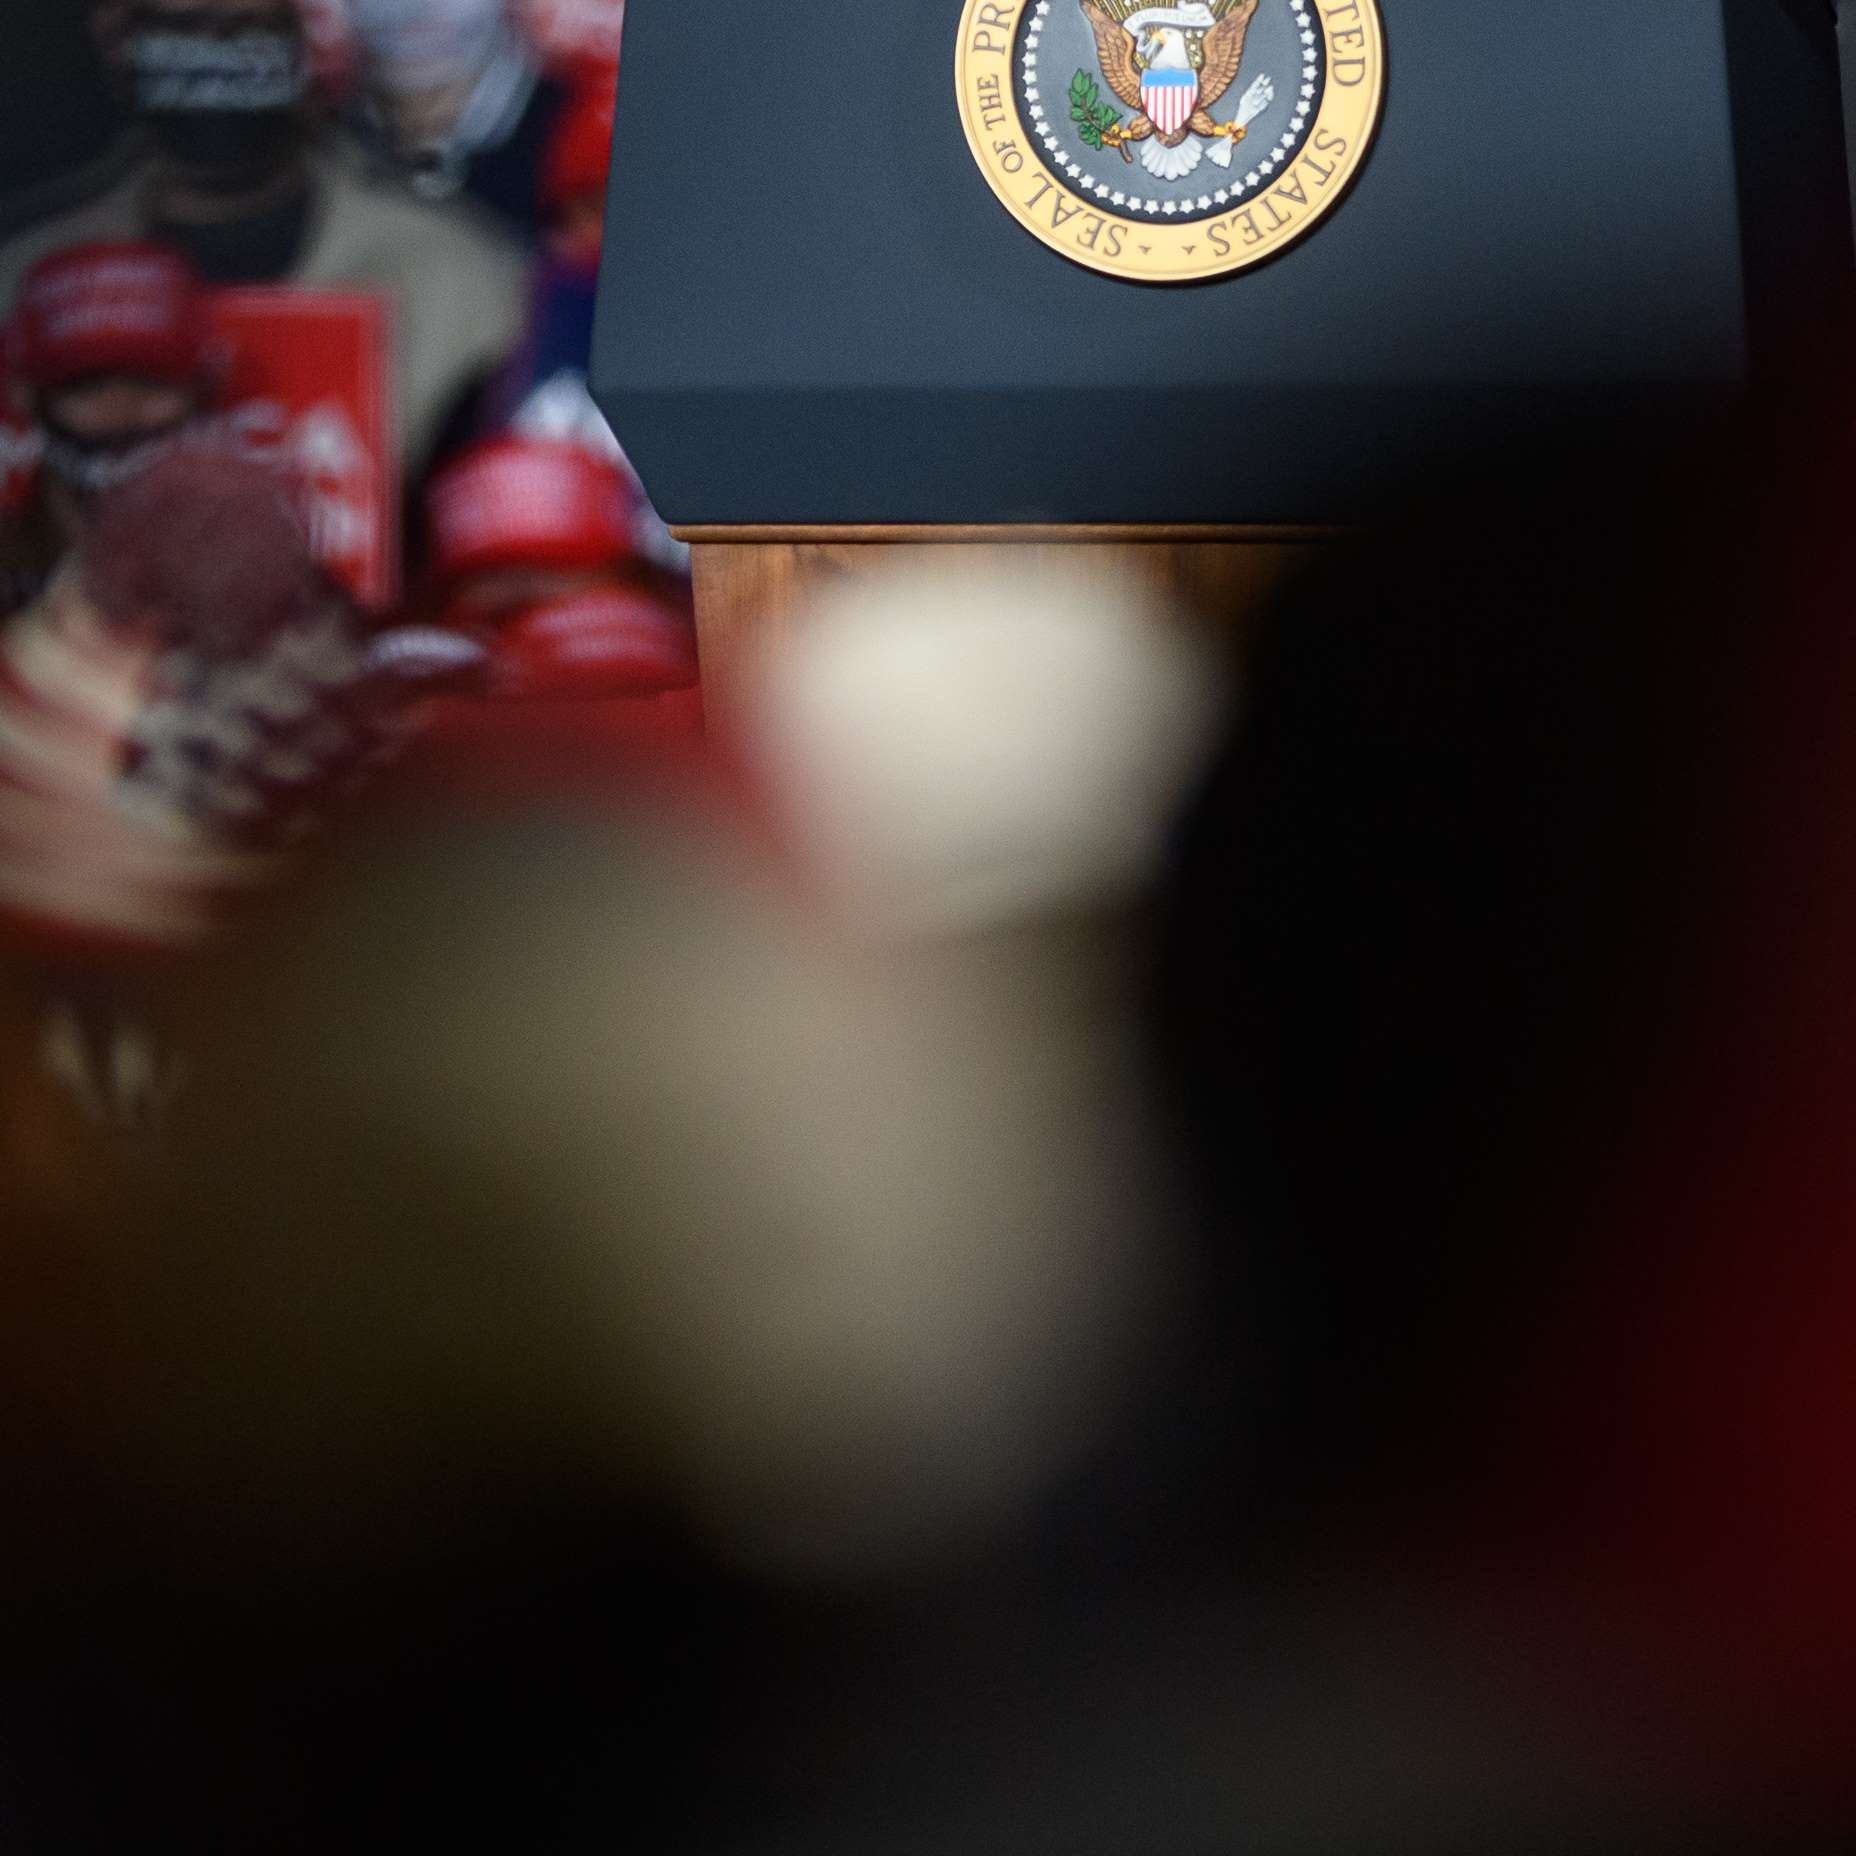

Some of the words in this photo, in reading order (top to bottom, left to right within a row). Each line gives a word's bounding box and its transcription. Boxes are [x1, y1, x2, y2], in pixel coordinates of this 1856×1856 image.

[976, 72, 1007, 131] THE
[992, 139, 1024, 175] OF
[1204, 127, 1348, 258] STATES
[1033, 172, 1129, 258] SEAL
